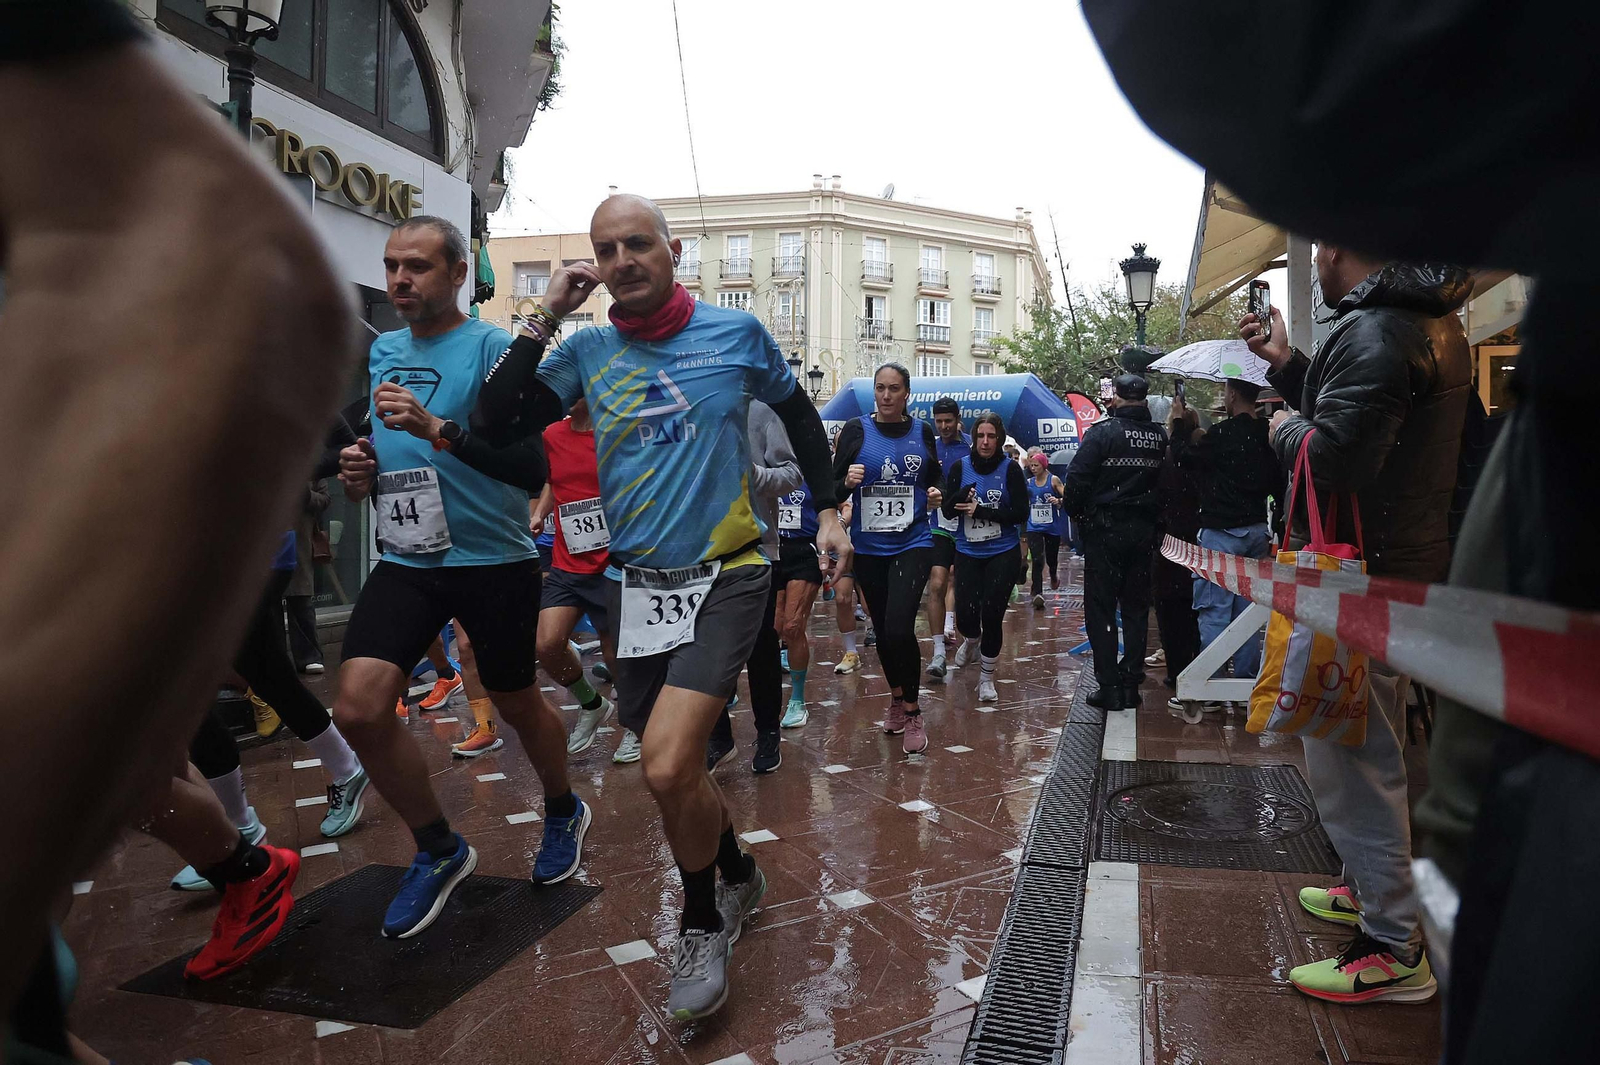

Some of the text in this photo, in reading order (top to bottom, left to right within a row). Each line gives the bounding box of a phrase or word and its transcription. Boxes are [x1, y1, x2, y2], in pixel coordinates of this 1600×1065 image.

[485, 347, 512, 383] KIPRUN
[676, 356, 722, 369] RUNNING
[906, 389, 1002, 406] yuntamiento
[910, 407, 927, 419] de
[1042, 422, 1054, 435] D
[1040, 443, 1079, 451] DEPORTES
[1130, 438, 1160, 450] LOCAL
[390, 497, 420, 526] 44
[873, 500, 906, 517] 313
[1036, 509, 1050, 518] 138
[571, 514, 607, 536] 381
[646, 592, 703, 626] 338
